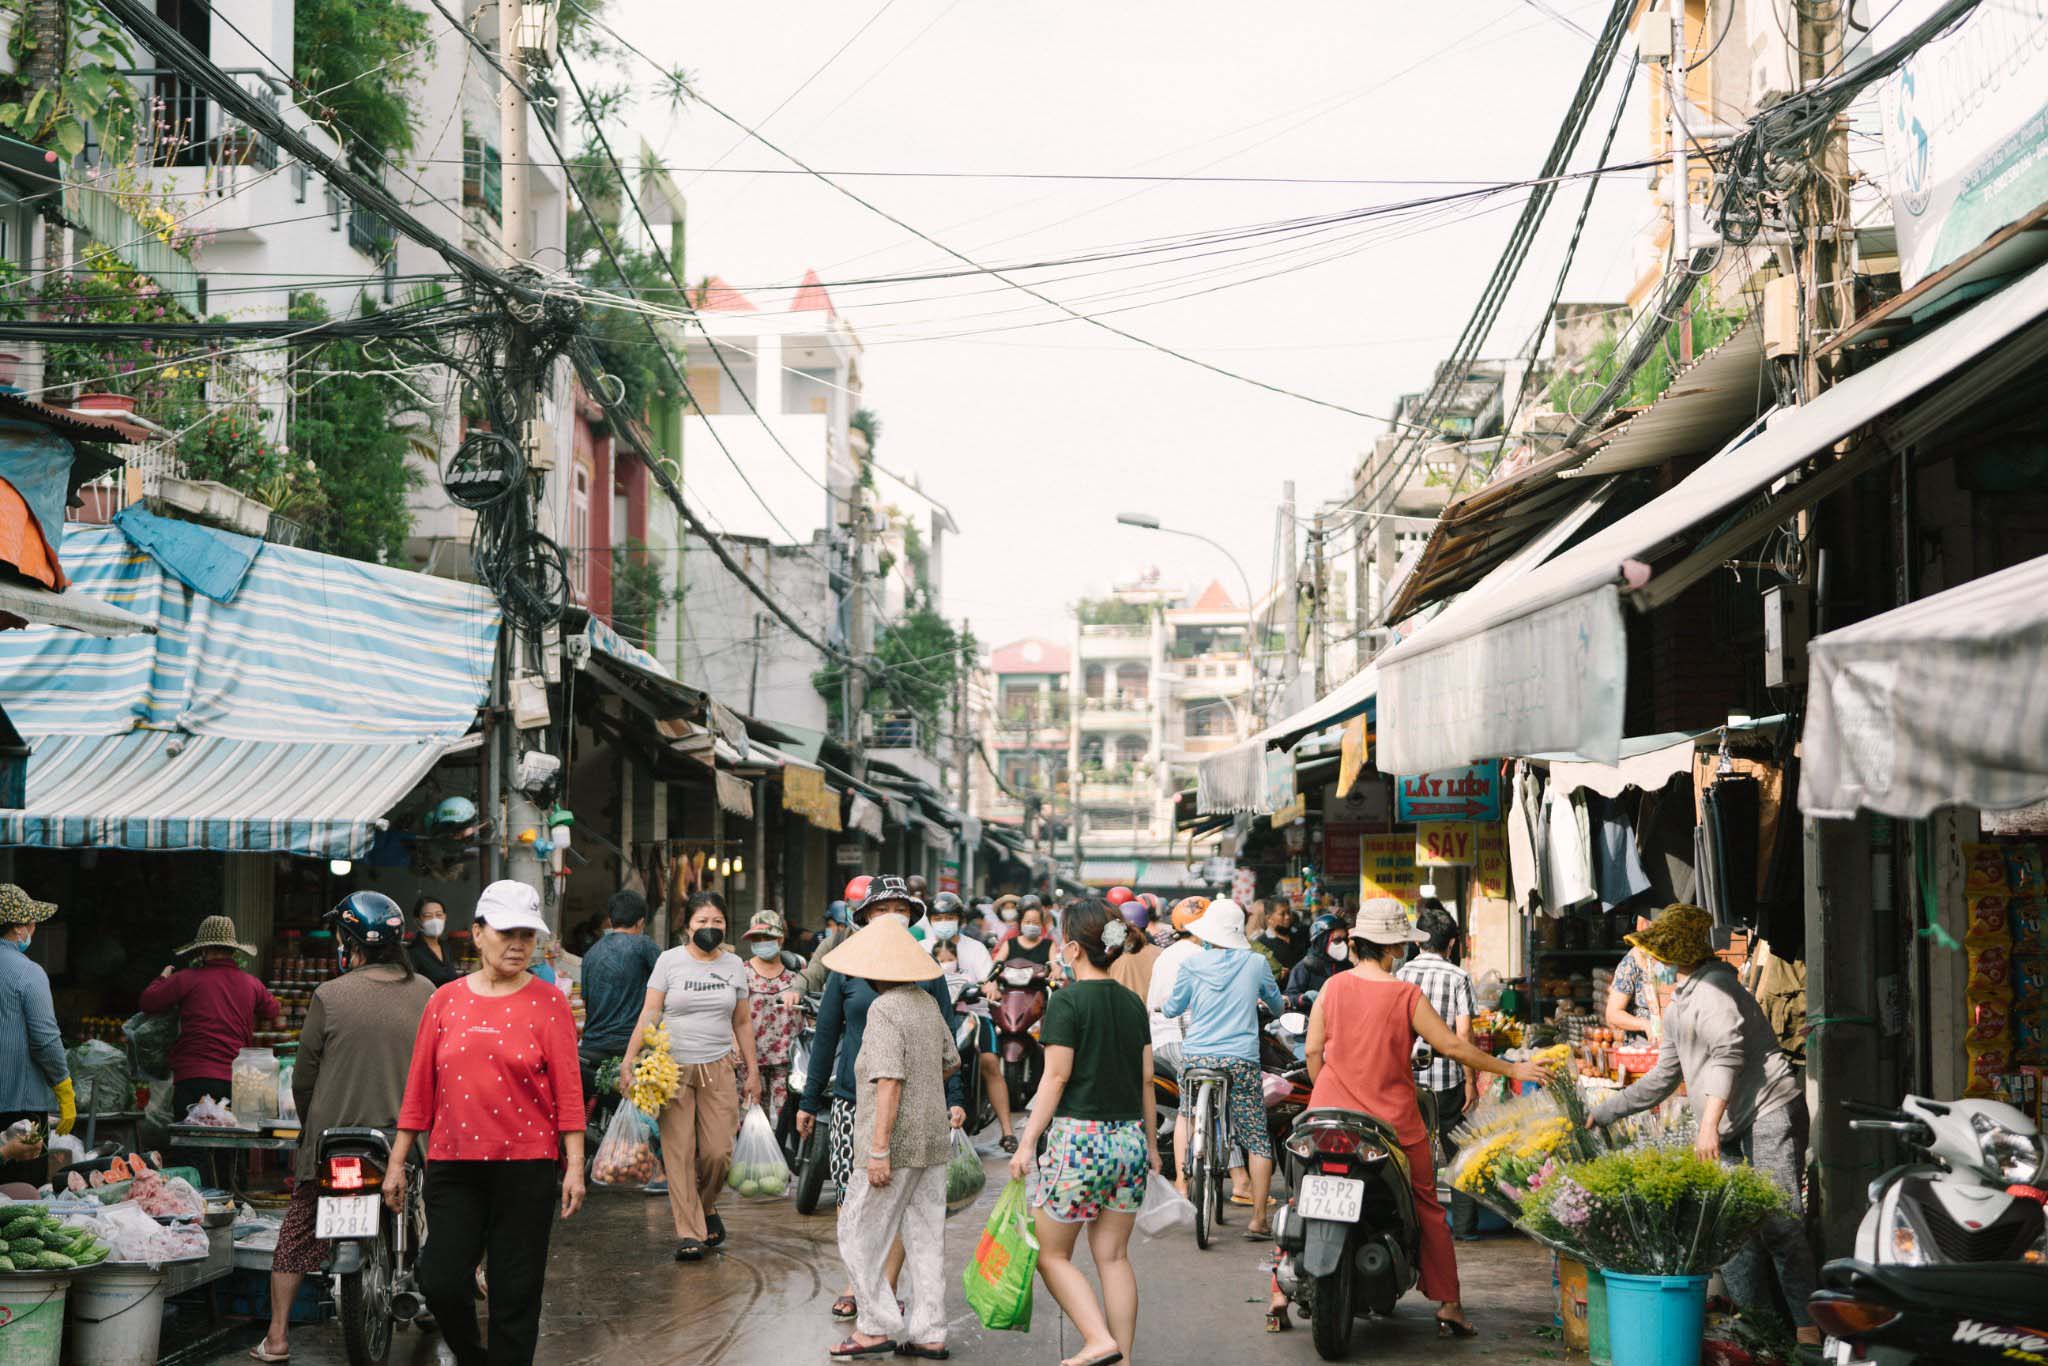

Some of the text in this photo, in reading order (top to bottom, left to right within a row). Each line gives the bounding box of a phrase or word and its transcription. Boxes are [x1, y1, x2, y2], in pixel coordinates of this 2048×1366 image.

[1427, 824, 1469, 859] SẤY
[1311, 1180, 1355, 1200] 59-P2
[1951, 1317, 2048, 1351] Wave
